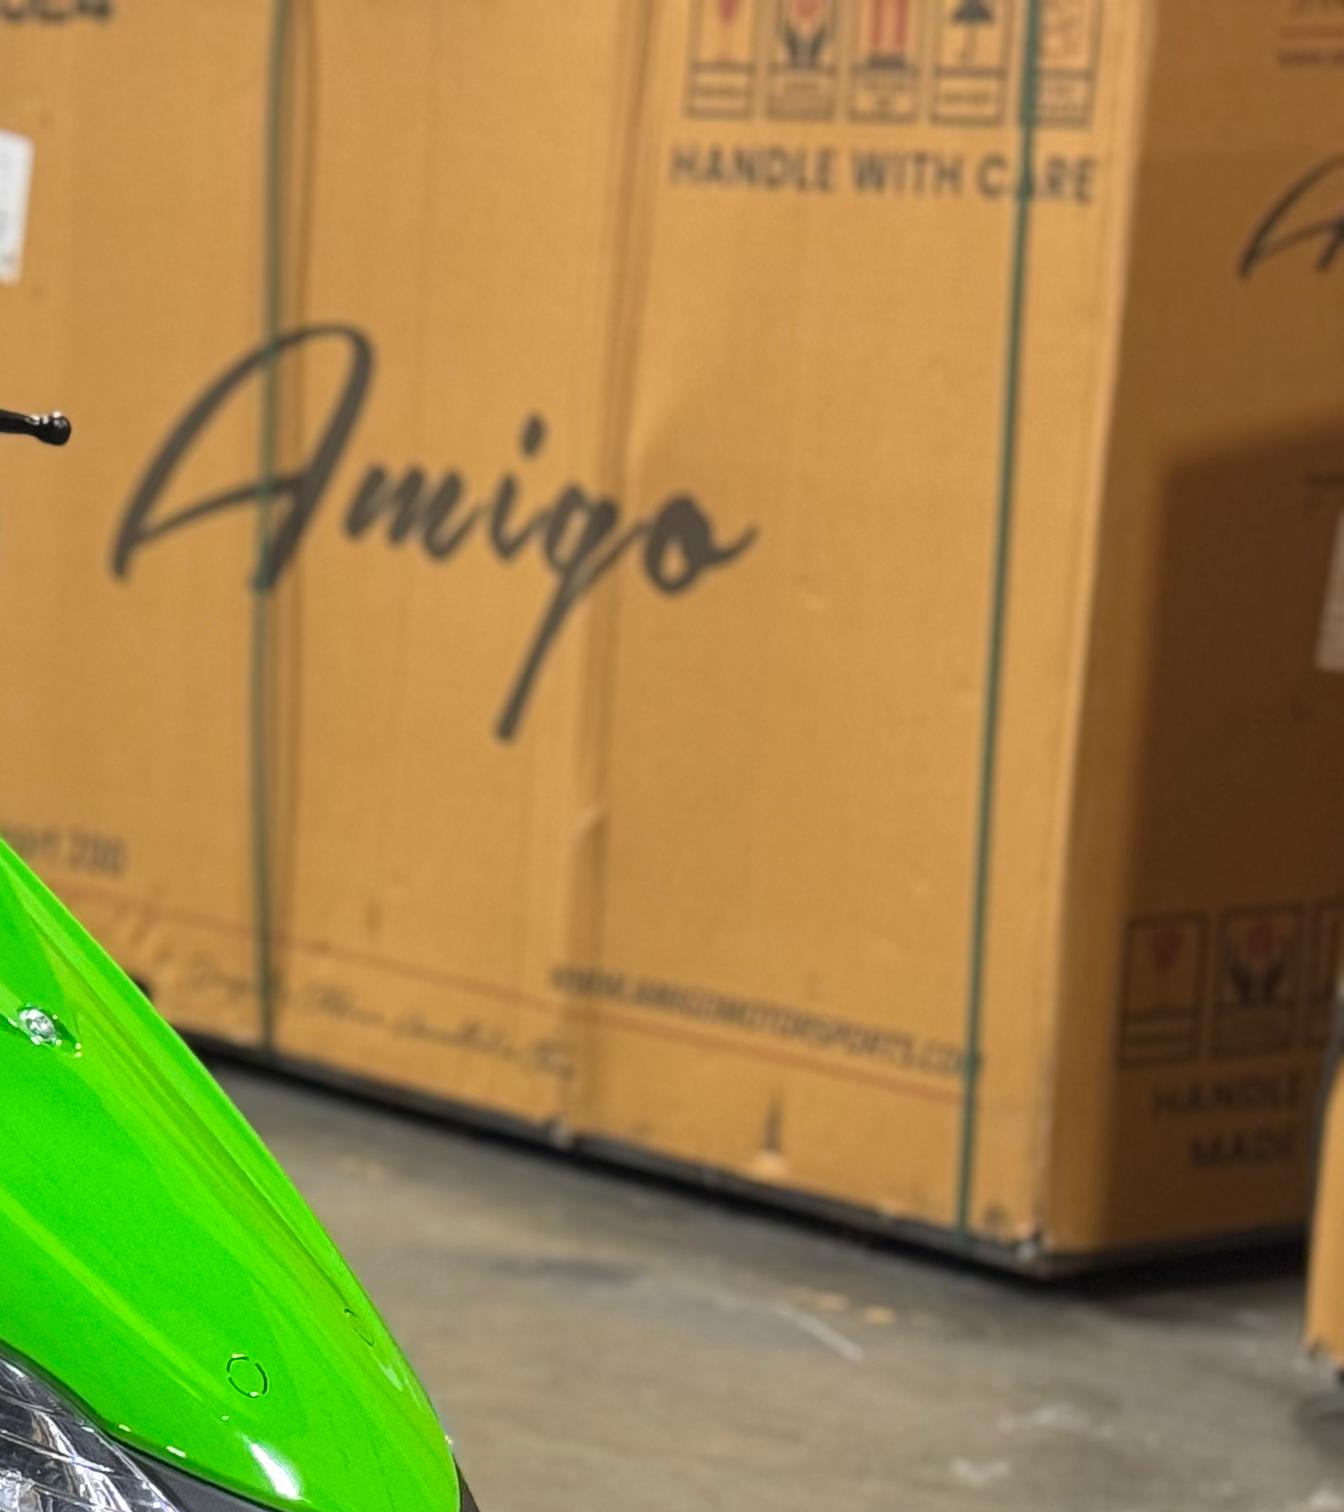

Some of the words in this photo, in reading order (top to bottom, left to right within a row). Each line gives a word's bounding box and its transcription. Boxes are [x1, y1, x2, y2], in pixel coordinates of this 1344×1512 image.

[670, 145, 837, 193] HANDLE
[849, 150, 964, 197] WITH
[108, 322, 760, 744] Amigo
